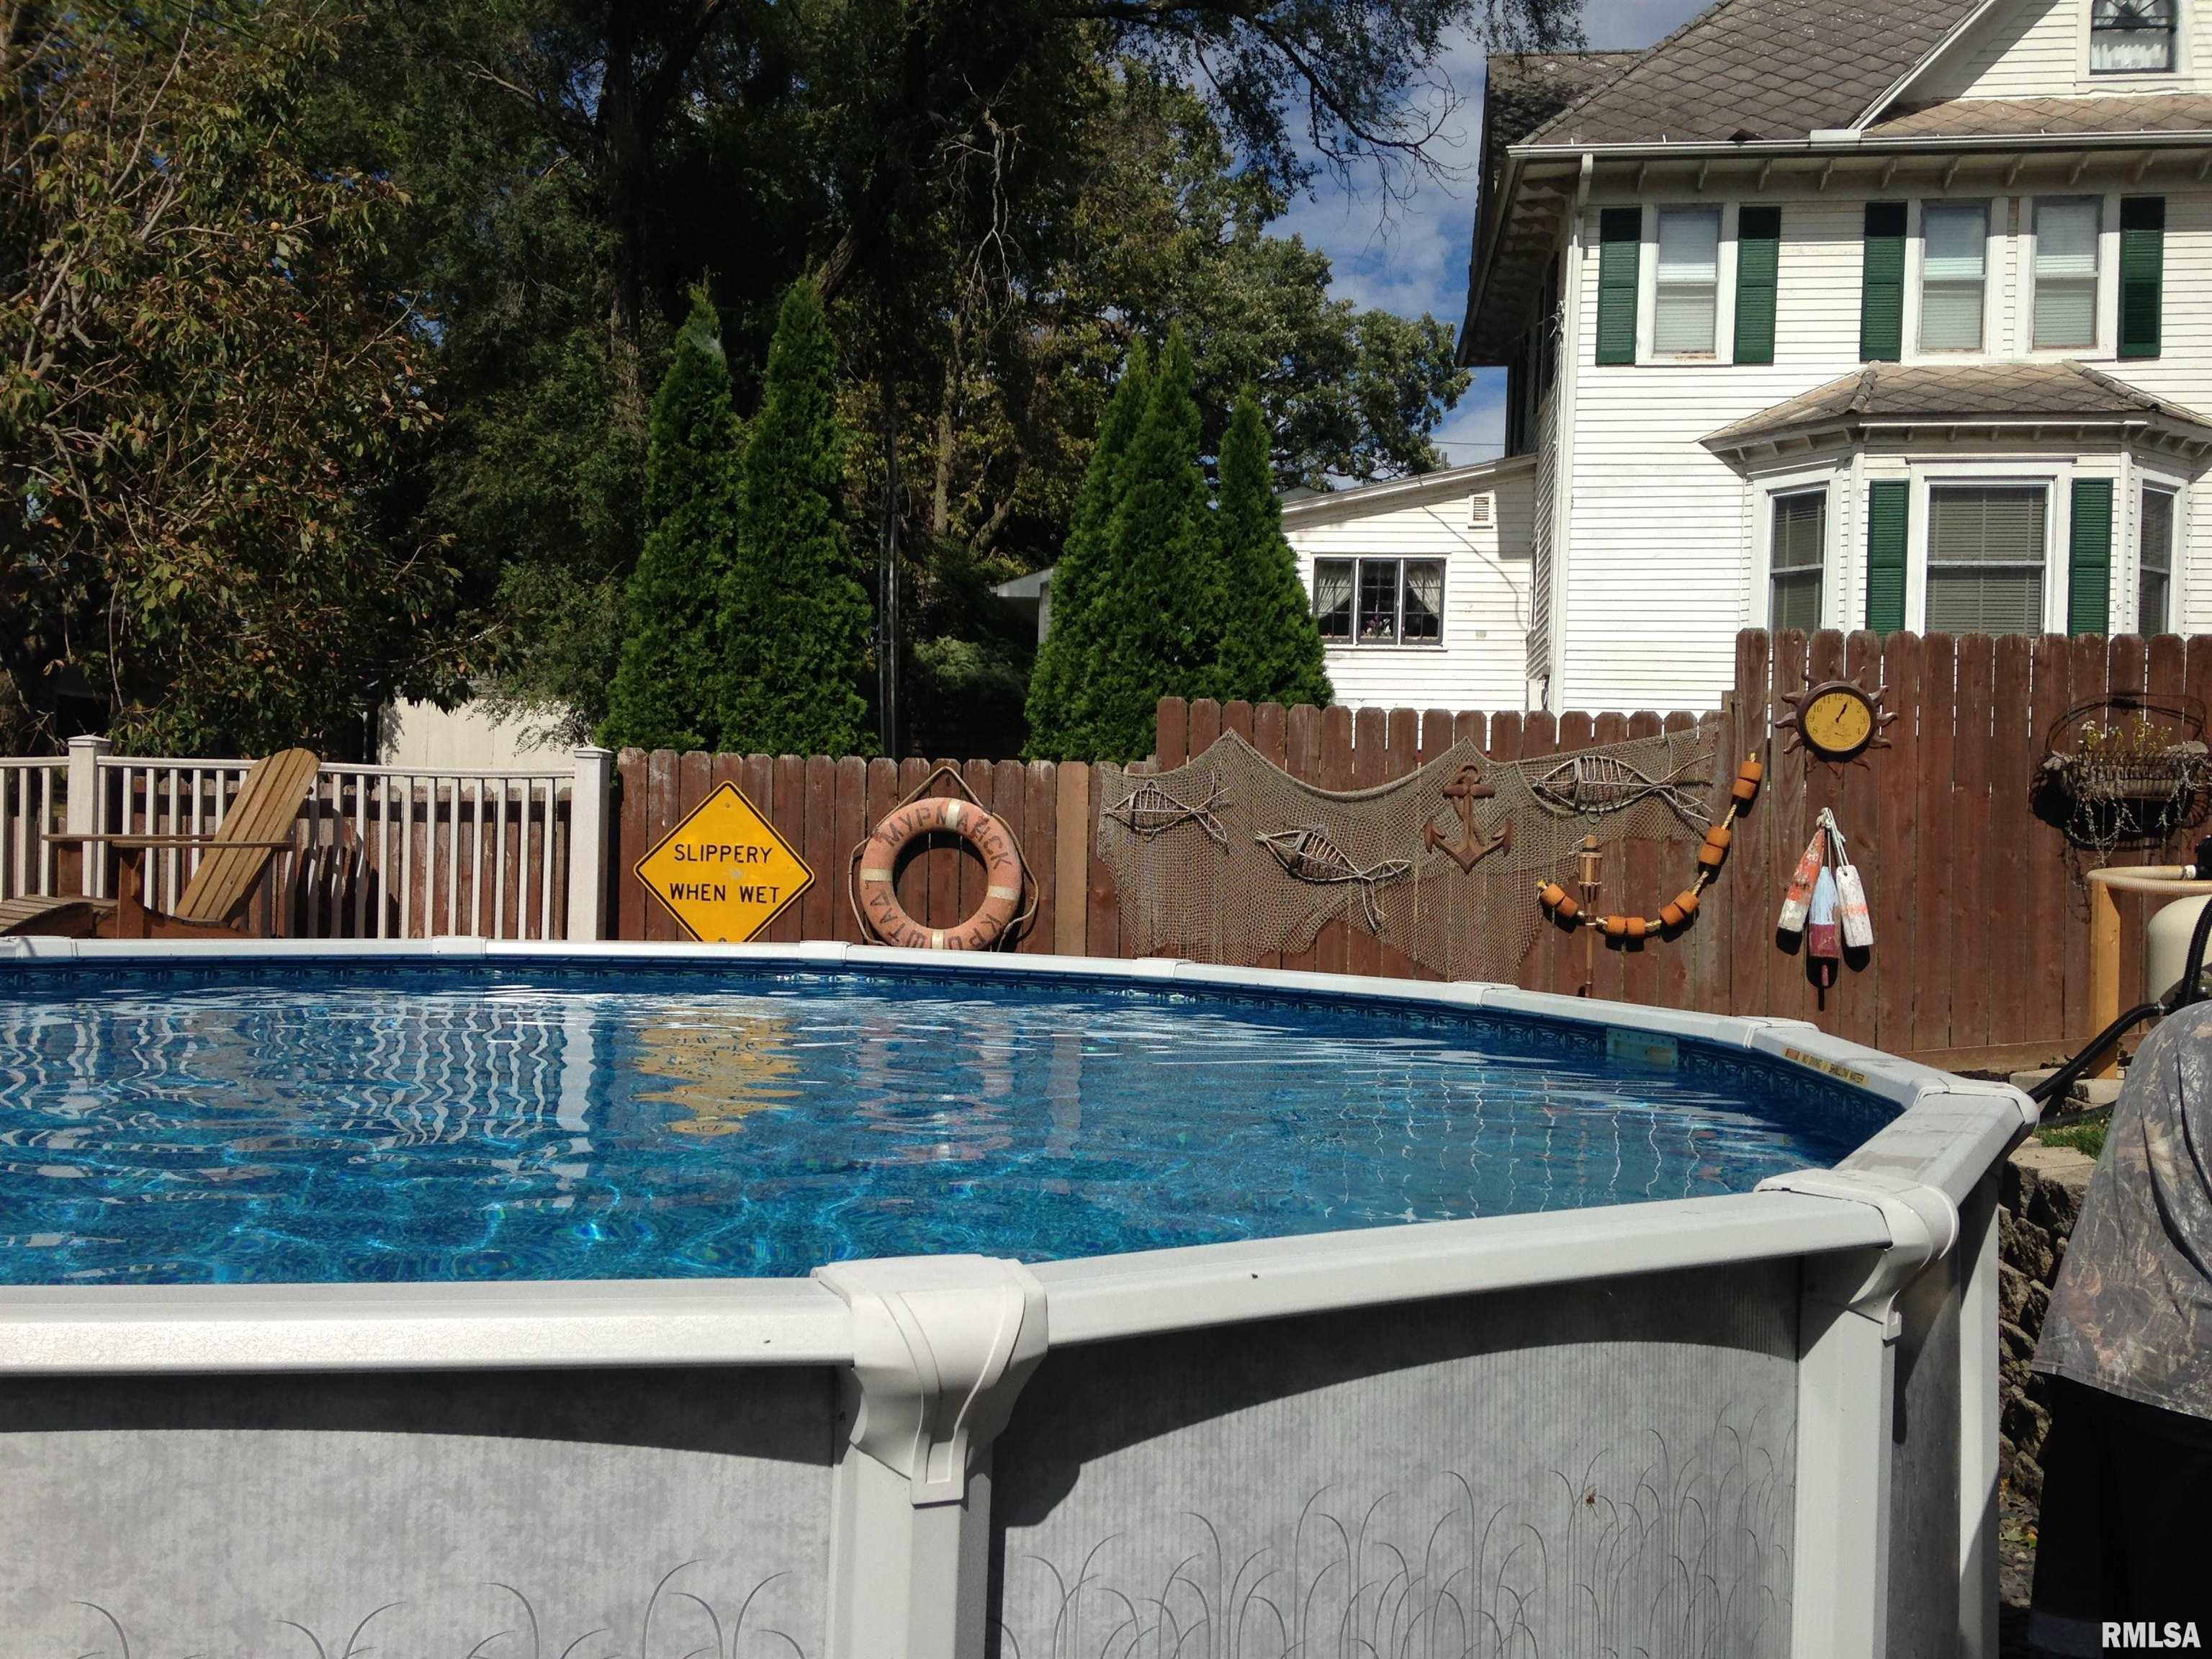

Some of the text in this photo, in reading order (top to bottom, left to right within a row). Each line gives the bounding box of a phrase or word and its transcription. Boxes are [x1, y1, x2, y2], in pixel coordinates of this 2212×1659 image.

[674, 844, 773, 863] SLIPPERY
[670, 883, 780, 904] WHEN WET
